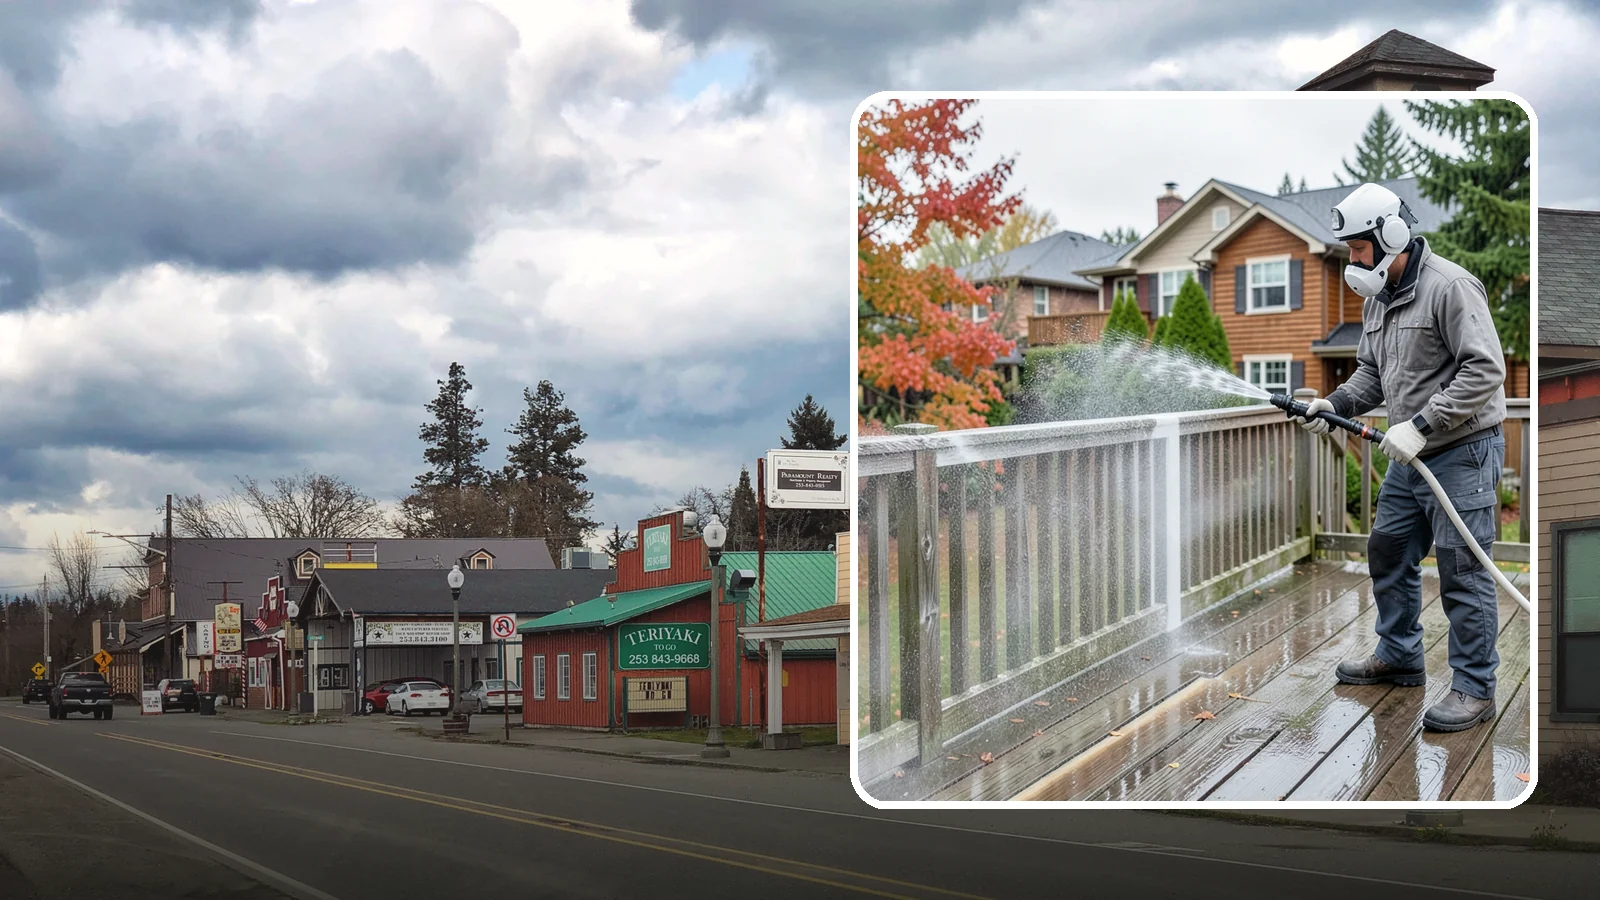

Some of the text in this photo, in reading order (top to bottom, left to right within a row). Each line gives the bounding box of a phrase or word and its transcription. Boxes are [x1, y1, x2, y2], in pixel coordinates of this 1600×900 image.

[624, 628, 702, 646] TERIYAKI
[629, 654, 700, 664] 253 843-9668
